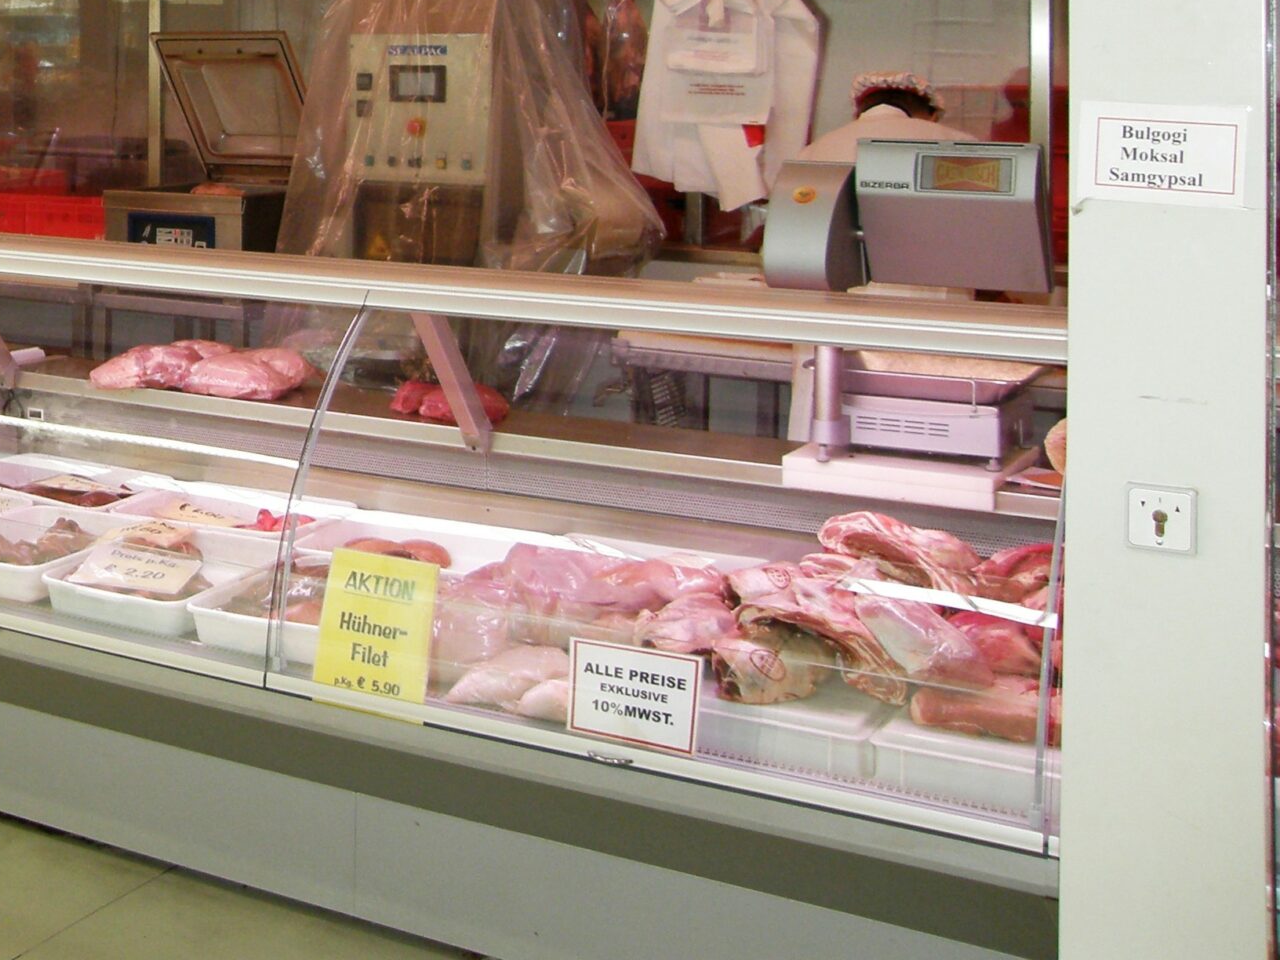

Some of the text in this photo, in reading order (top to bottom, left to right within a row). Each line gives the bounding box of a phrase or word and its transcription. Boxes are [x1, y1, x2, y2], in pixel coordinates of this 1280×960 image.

[1121, 124, 1188, 146] Bulgogi
[1120, 146, 1185, 164] Moksal
[859, 180, 910, 190] BIZERBA
[1108, 166, 1204, 190] Samgypsal
[344, 570, 416, 601] AKTION
[339, 611, 408, 640] Hühner-
[350, 642, 390, 668] Filet
[583, 661, 688, 691] ALLE PREISE
[371, 680, 401, 697] 5.90
[599, 682, 669, 704] EXKLUSIVE
